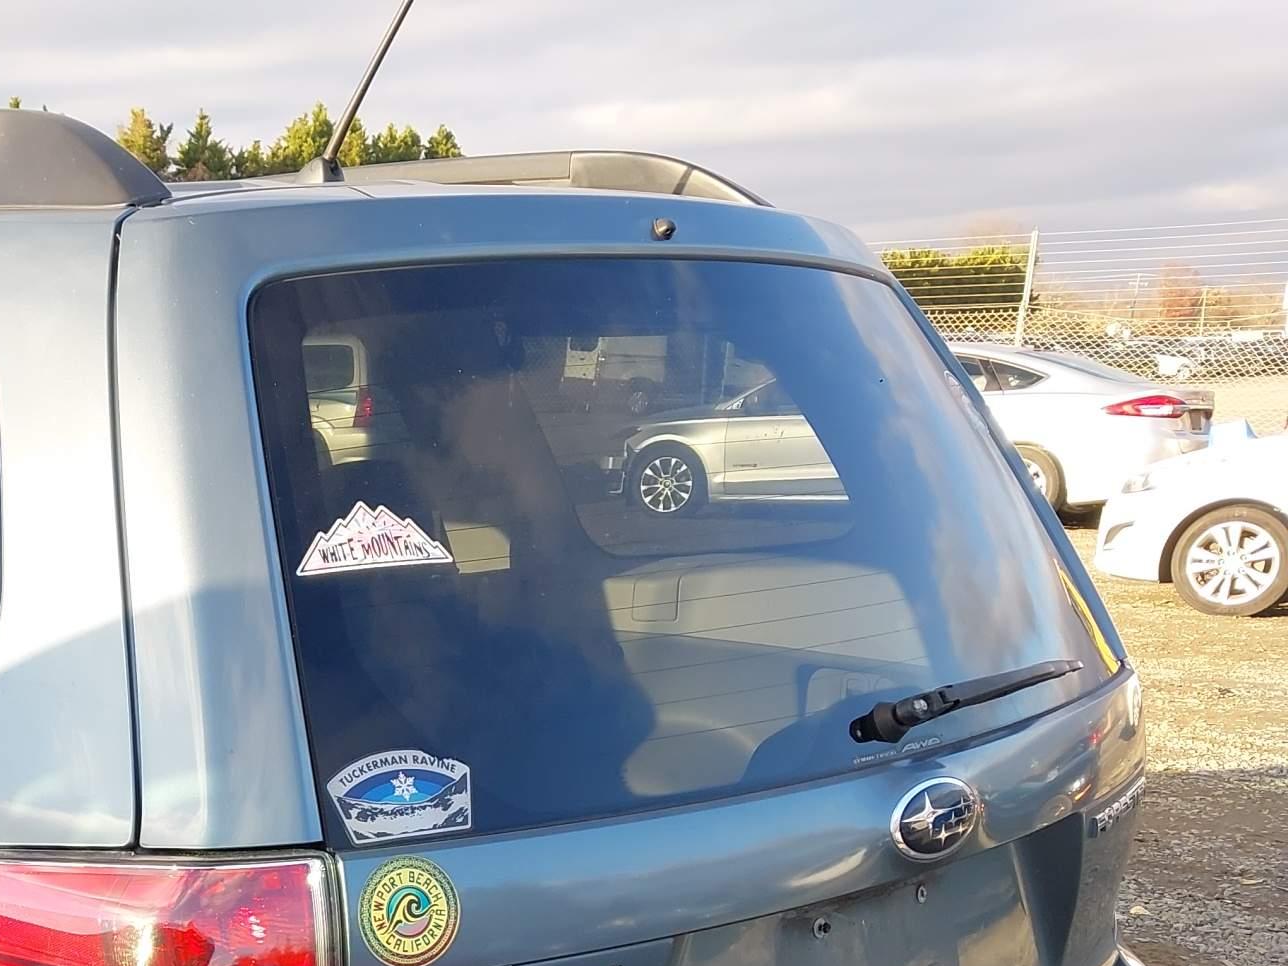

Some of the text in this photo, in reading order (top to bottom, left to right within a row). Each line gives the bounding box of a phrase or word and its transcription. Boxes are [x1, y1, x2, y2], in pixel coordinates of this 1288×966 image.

[318, 530, 431, 564] WHITE MOUNTAINS
[901, 736, 942, 753] AWD
[338, 754, 458, 787] TUCKERMAN RAVINE
[372, 870, 444, 932] NEWPORT BEACH
[385, 908, 447, 953] CALIFORNIA
